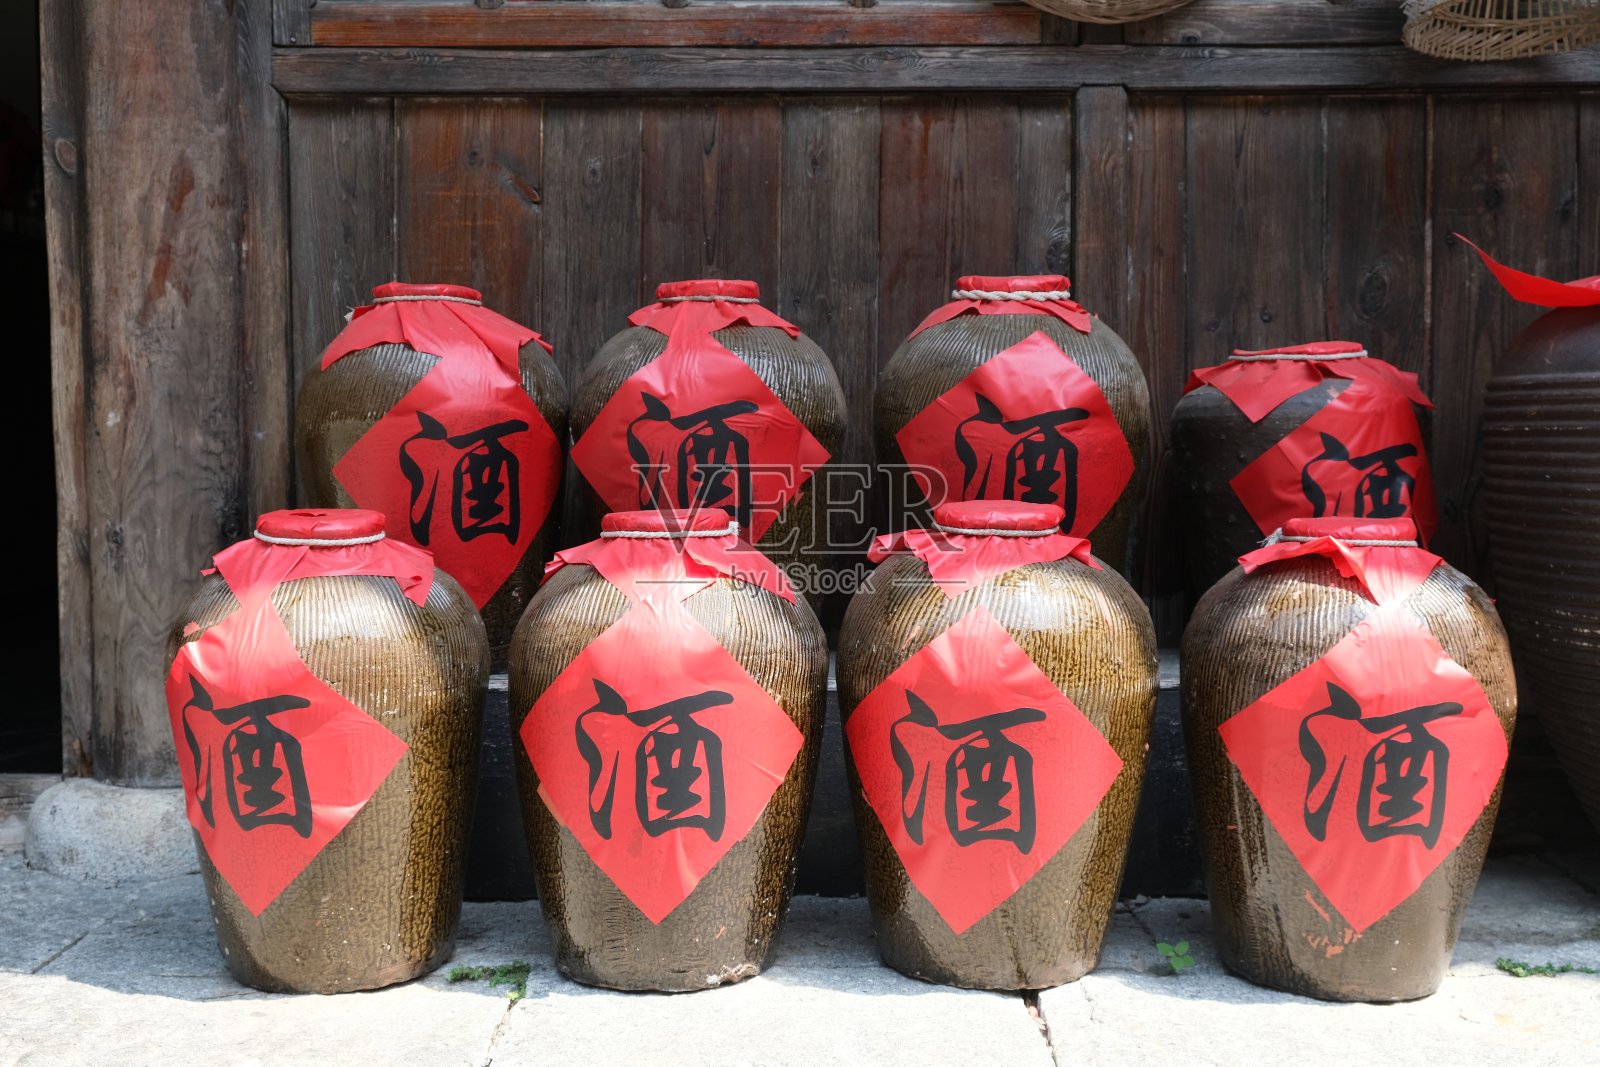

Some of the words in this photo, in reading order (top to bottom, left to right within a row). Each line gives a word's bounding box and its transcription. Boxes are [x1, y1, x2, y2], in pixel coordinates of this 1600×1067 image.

[399, 410, 529, 547] 酒
[627, 391, 760, 528] 酒
[954, 393, 1090, 534] 酒
[1301, 431, 1418, 518] 酒
[182, 673, 312, 839] 酒
[575, 678, 734, 843] 酒
[889, 689, 1047, 856] 酒
[1299, 680, 1464, 850] 酒
